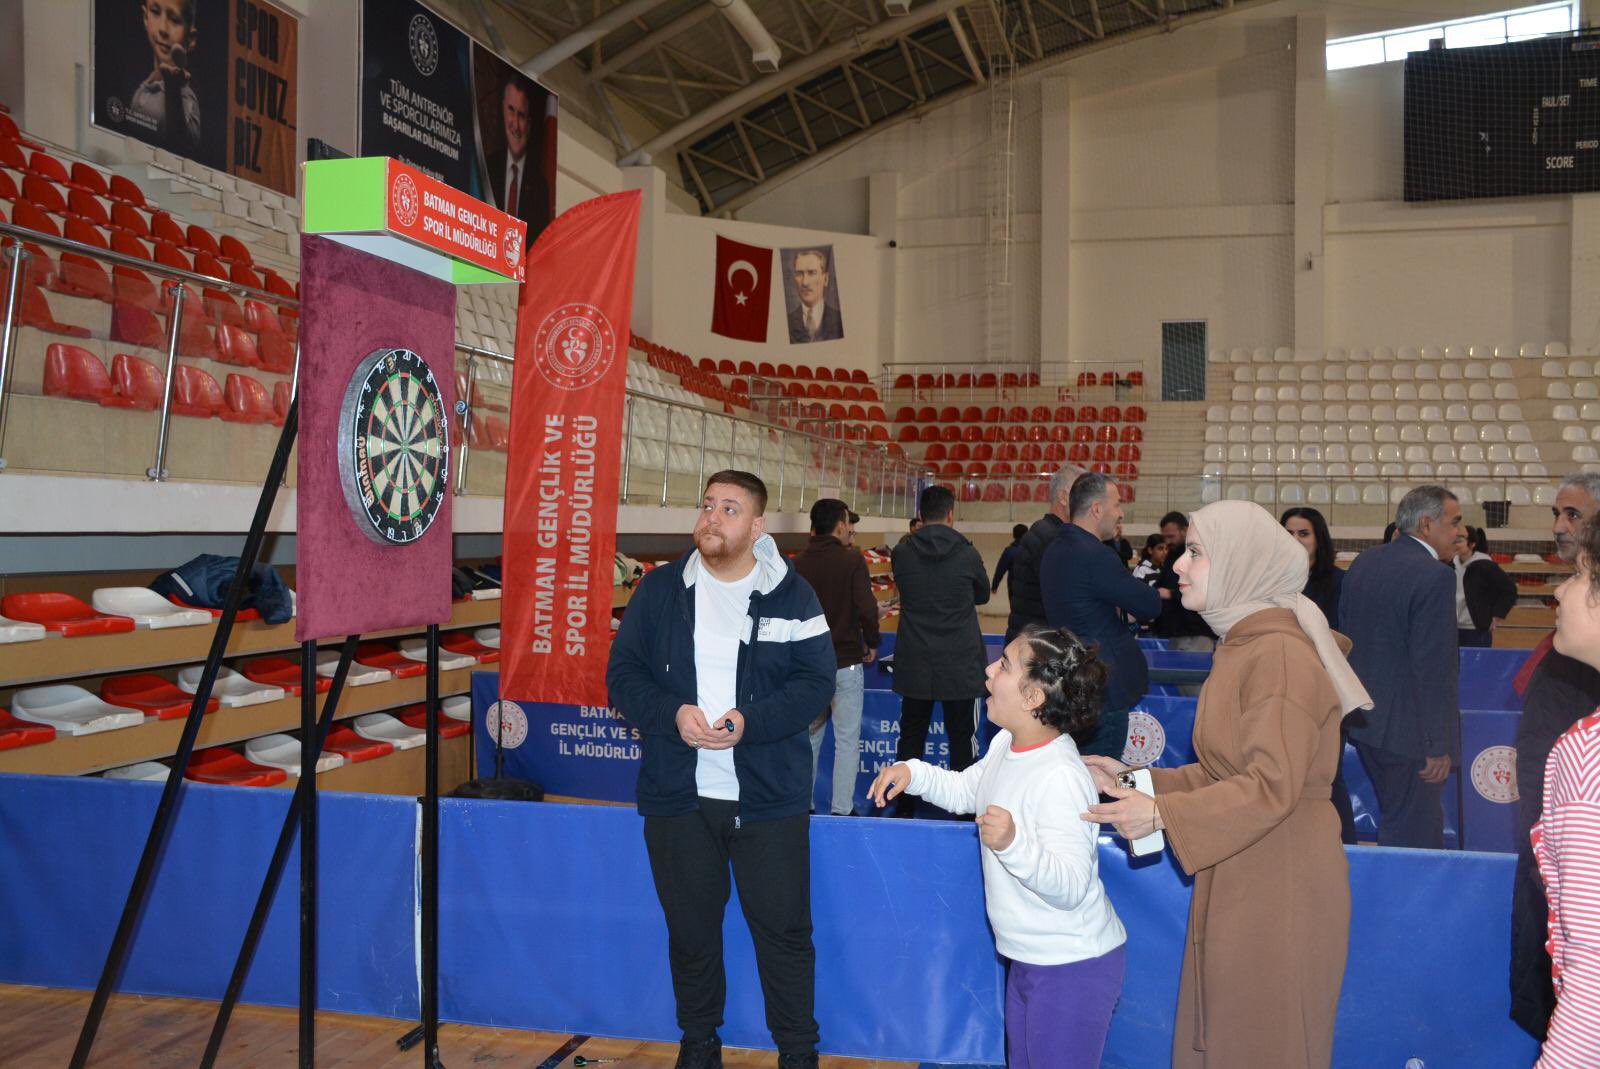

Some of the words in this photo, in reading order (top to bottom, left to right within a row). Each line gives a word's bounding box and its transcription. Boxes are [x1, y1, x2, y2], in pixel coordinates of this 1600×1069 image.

[380, 90, 392, 110] VE
[392, 98, 462, 146] SPORCULARIMIZA
[390, 78, 410, 102] TÜM
[411, 92, 454, 126] ANTRENÖR
[382, 112, 423, 142] BAŞARILAR
[423, 132, 459, 161] DİLİYORUM
[1545, 155, 1575, 170] SCORE
[423, 191, 456, 219] BATMAN
[458, 207, 487, 234] GENÇLİK
[488, 220, 498, 238] VE
[423, 216, 445, 237] SPOR
[445, 223, 452, 241] İL
[452, 229, 497, 259] MÜDÜRLÜĞÜ
[545, 413, 565, 444] VE
[537, 449, 566, 549] GENÇLİK
[566, 415, 598, 566] MÜDÜRLÜĞÜ
[563, 570, 589, 590] İL
[532, 557, 557, 655] BATMAN
[565, 595, 588, 657] SPOR
[550, 722, 607, 740] GENÇLİK
[609, 726, 627, 740] VE
[559, 739, 572, 755] İL
